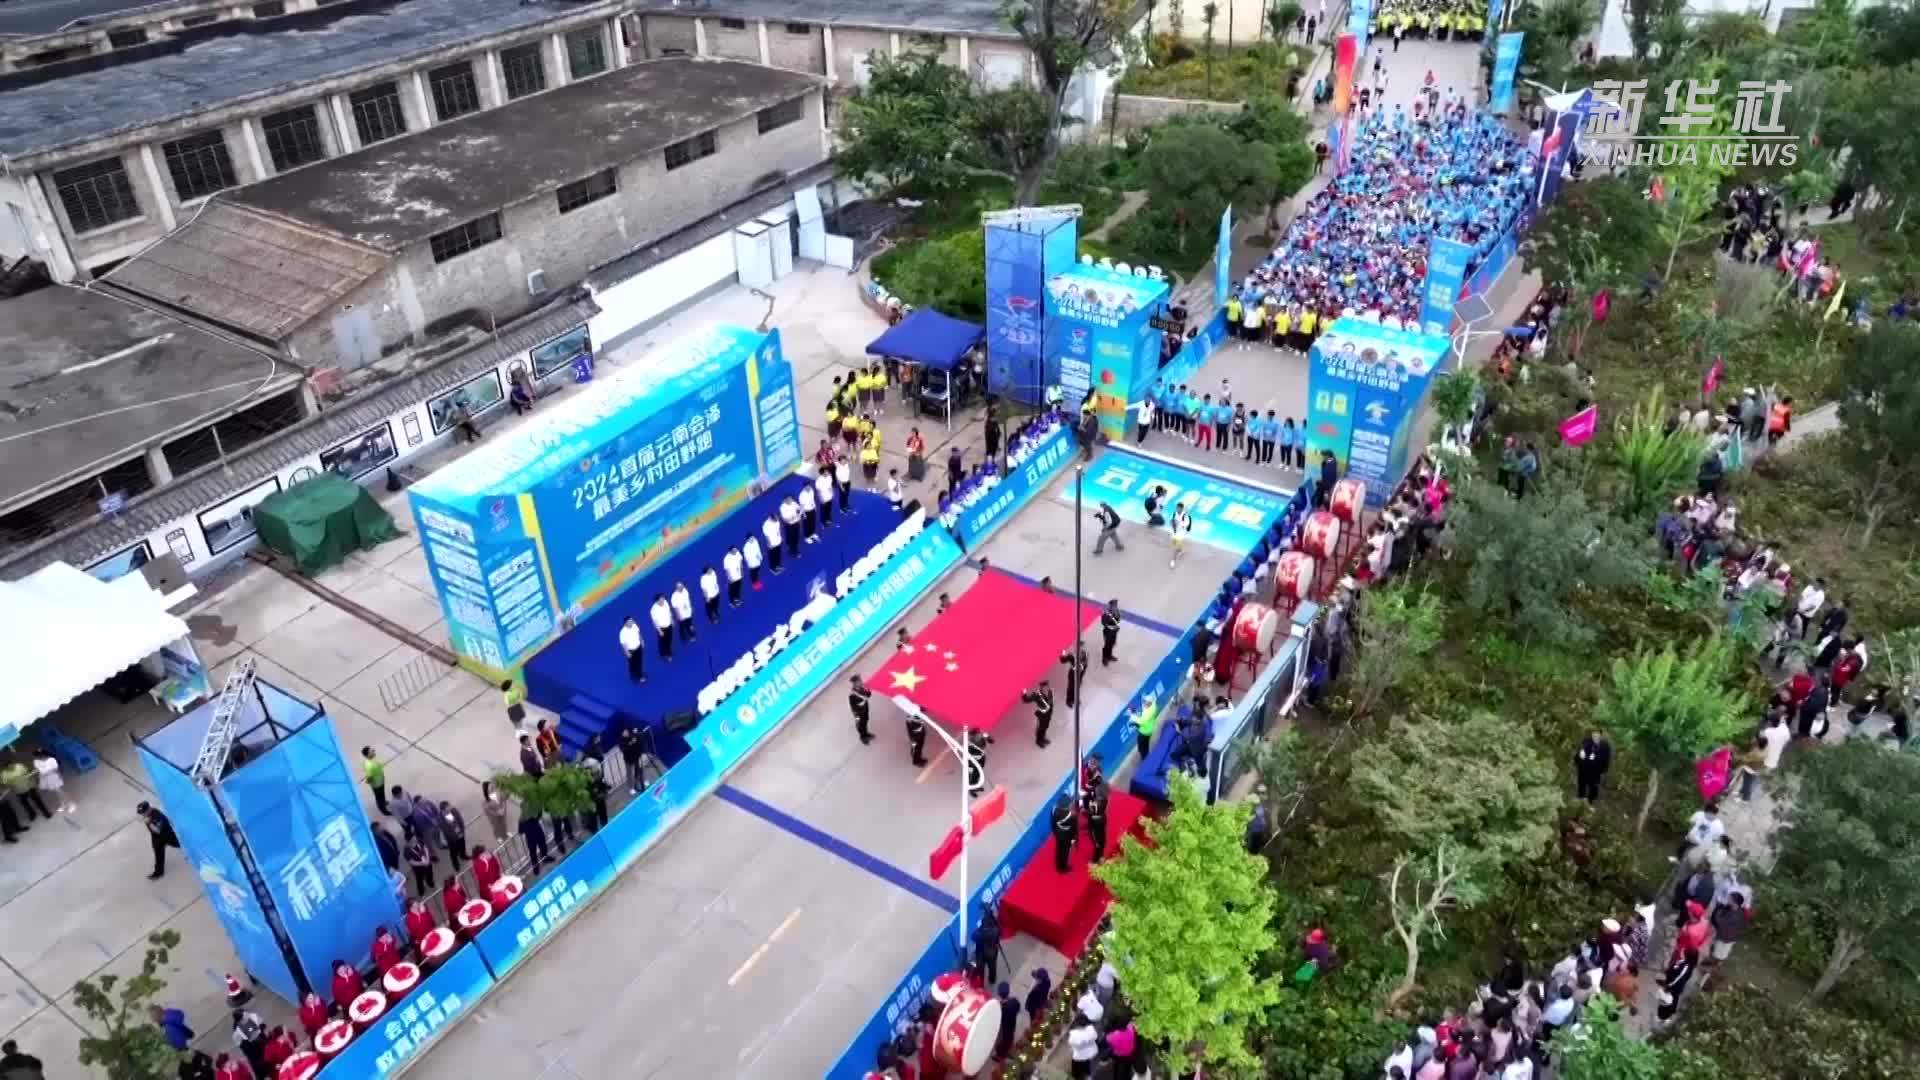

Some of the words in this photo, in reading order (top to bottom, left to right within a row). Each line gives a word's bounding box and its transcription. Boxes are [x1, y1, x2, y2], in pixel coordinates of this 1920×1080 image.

[572, 402, 721, 510] 2024首届云南会泽
[593, 429, 714, 521] 最美乡村田野跑
